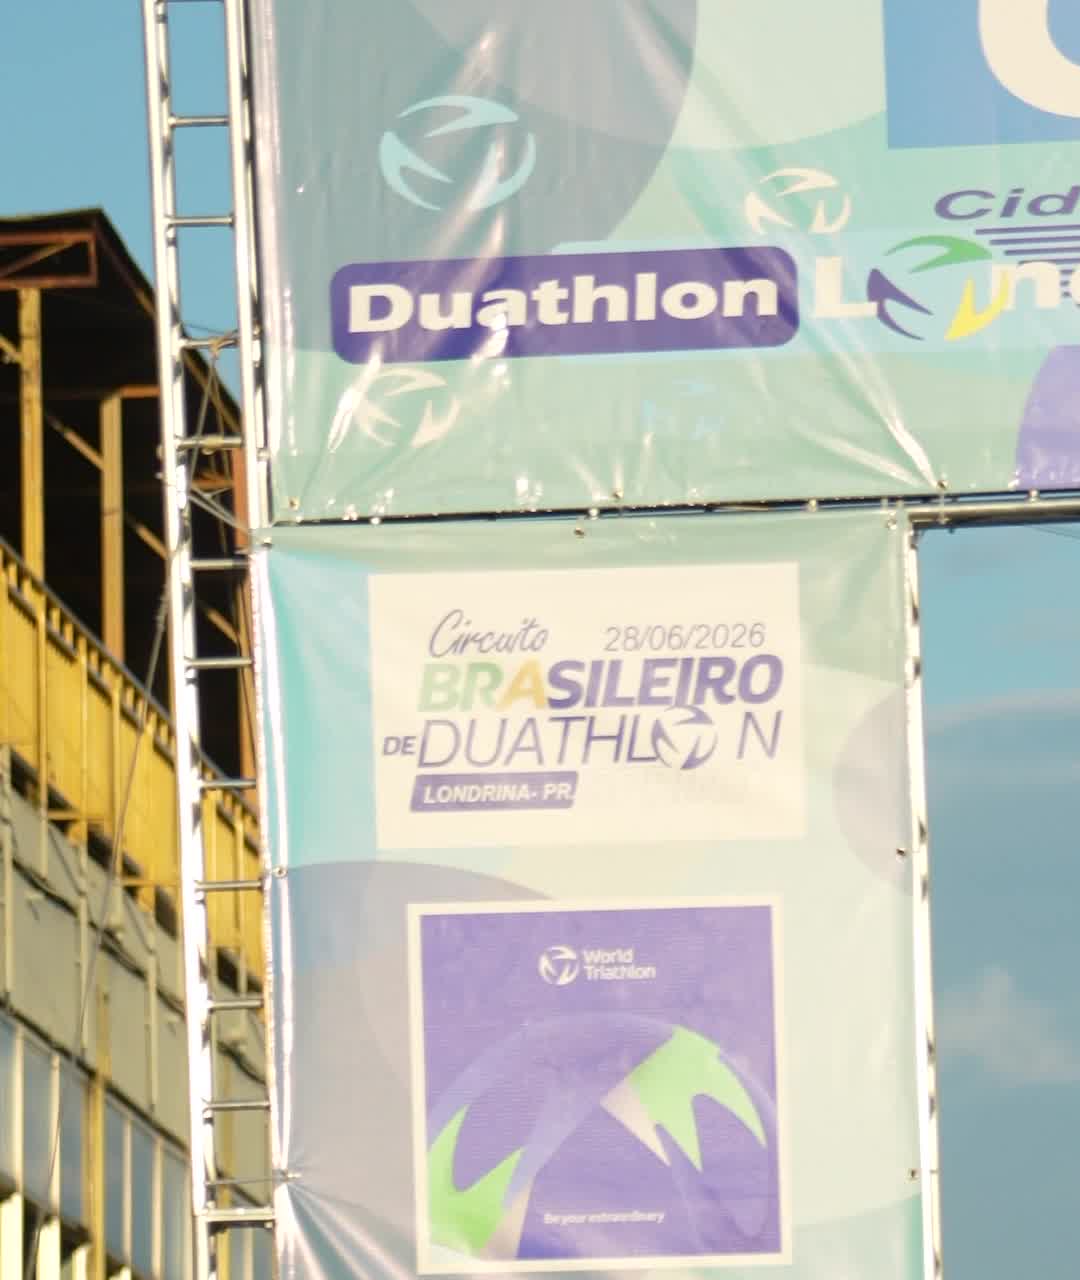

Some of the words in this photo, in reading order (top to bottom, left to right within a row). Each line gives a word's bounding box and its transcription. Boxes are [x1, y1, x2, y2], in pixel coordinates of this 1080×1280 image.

[347, 272, 778, 335] Duathlon
[429, 608, 550, 659] Circuito
[603, 622, 766, 652] 28/06/2026
[416, 652, 785, 713] BRASILEIRO
[382, 735, 417, 757] DE
[583, 947, 634, 964] World
[583, 964, 657, 982] Triathlon
